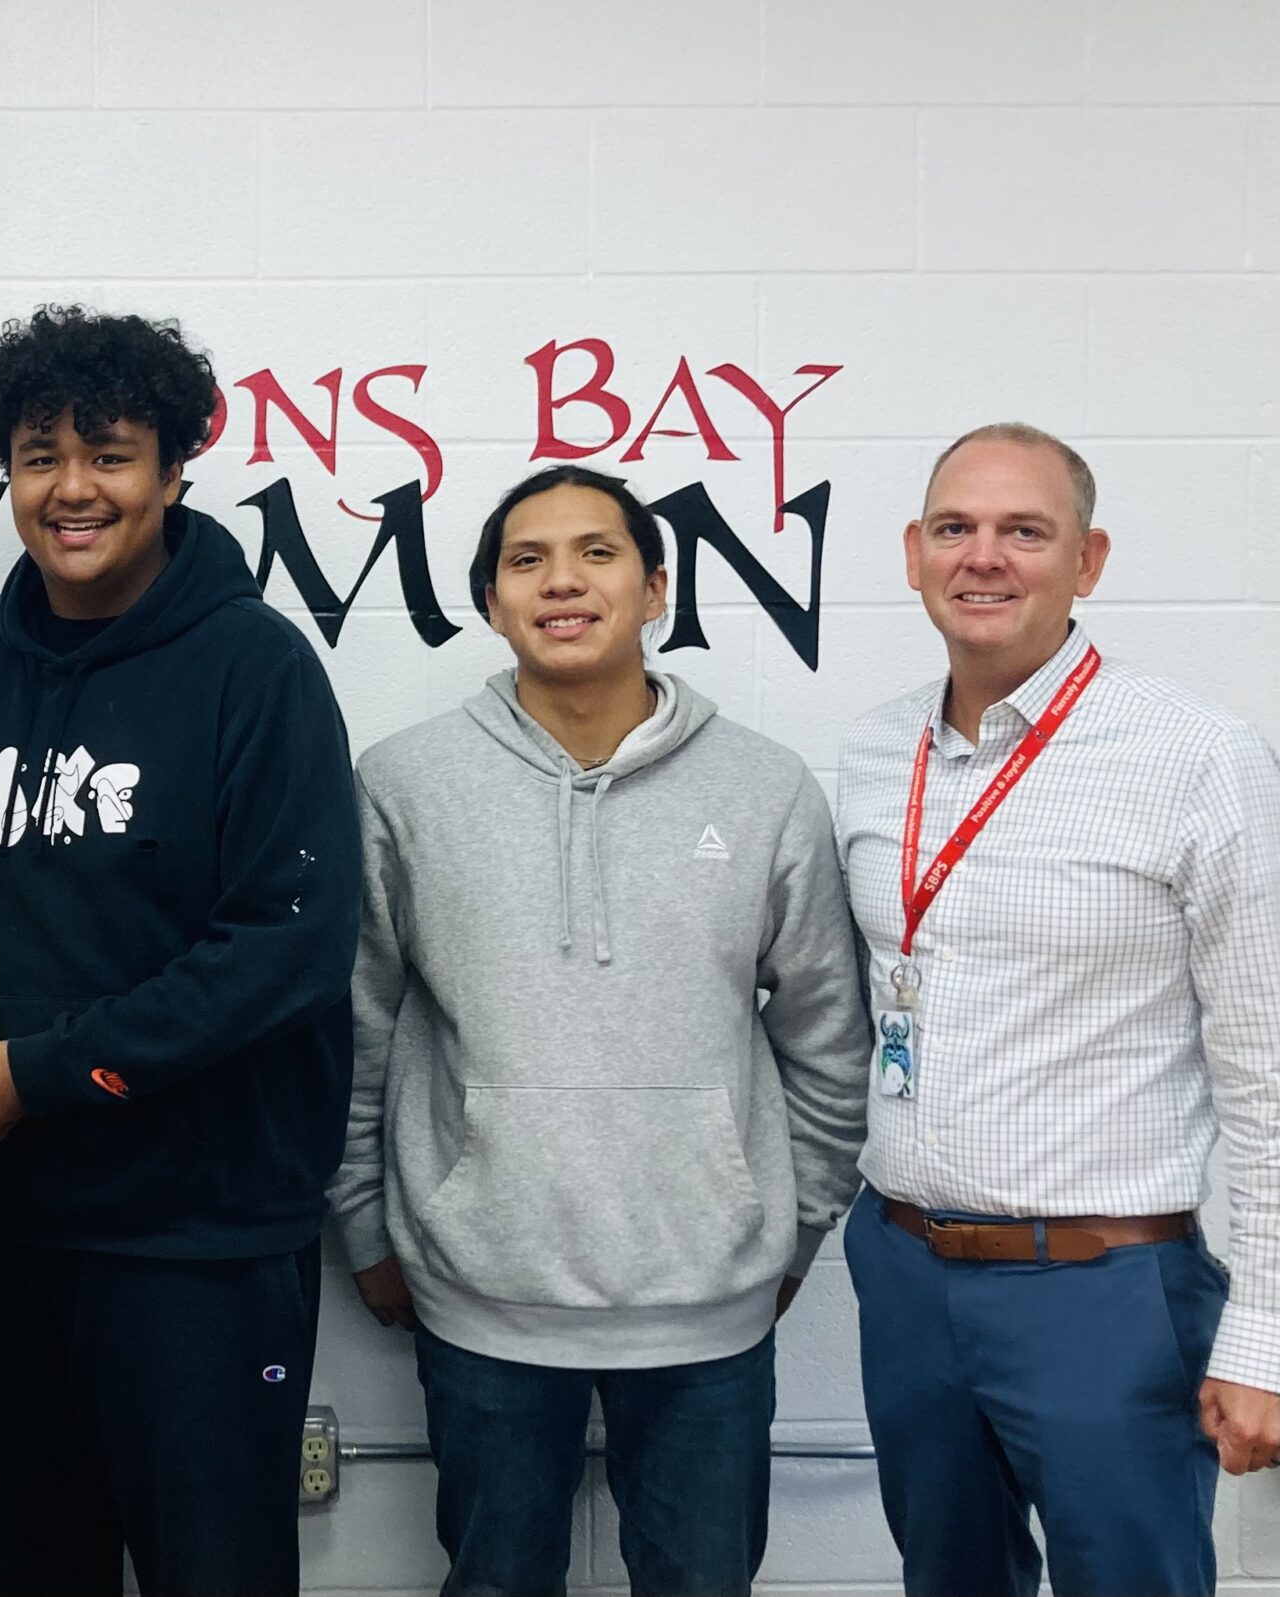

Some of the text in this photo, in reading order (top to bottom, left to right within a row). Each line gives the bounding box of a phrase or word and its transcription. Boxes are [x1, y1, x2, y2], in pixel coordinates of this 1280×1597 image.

[524, 337, 844, 533] BAY
[1051, 682, 1080, 717] Fiercely
[970, 753, 1027, 823] Positive & Joyful
[906, 807, 917, 846] Problem
[924, 860, 948, 892] SBPS
